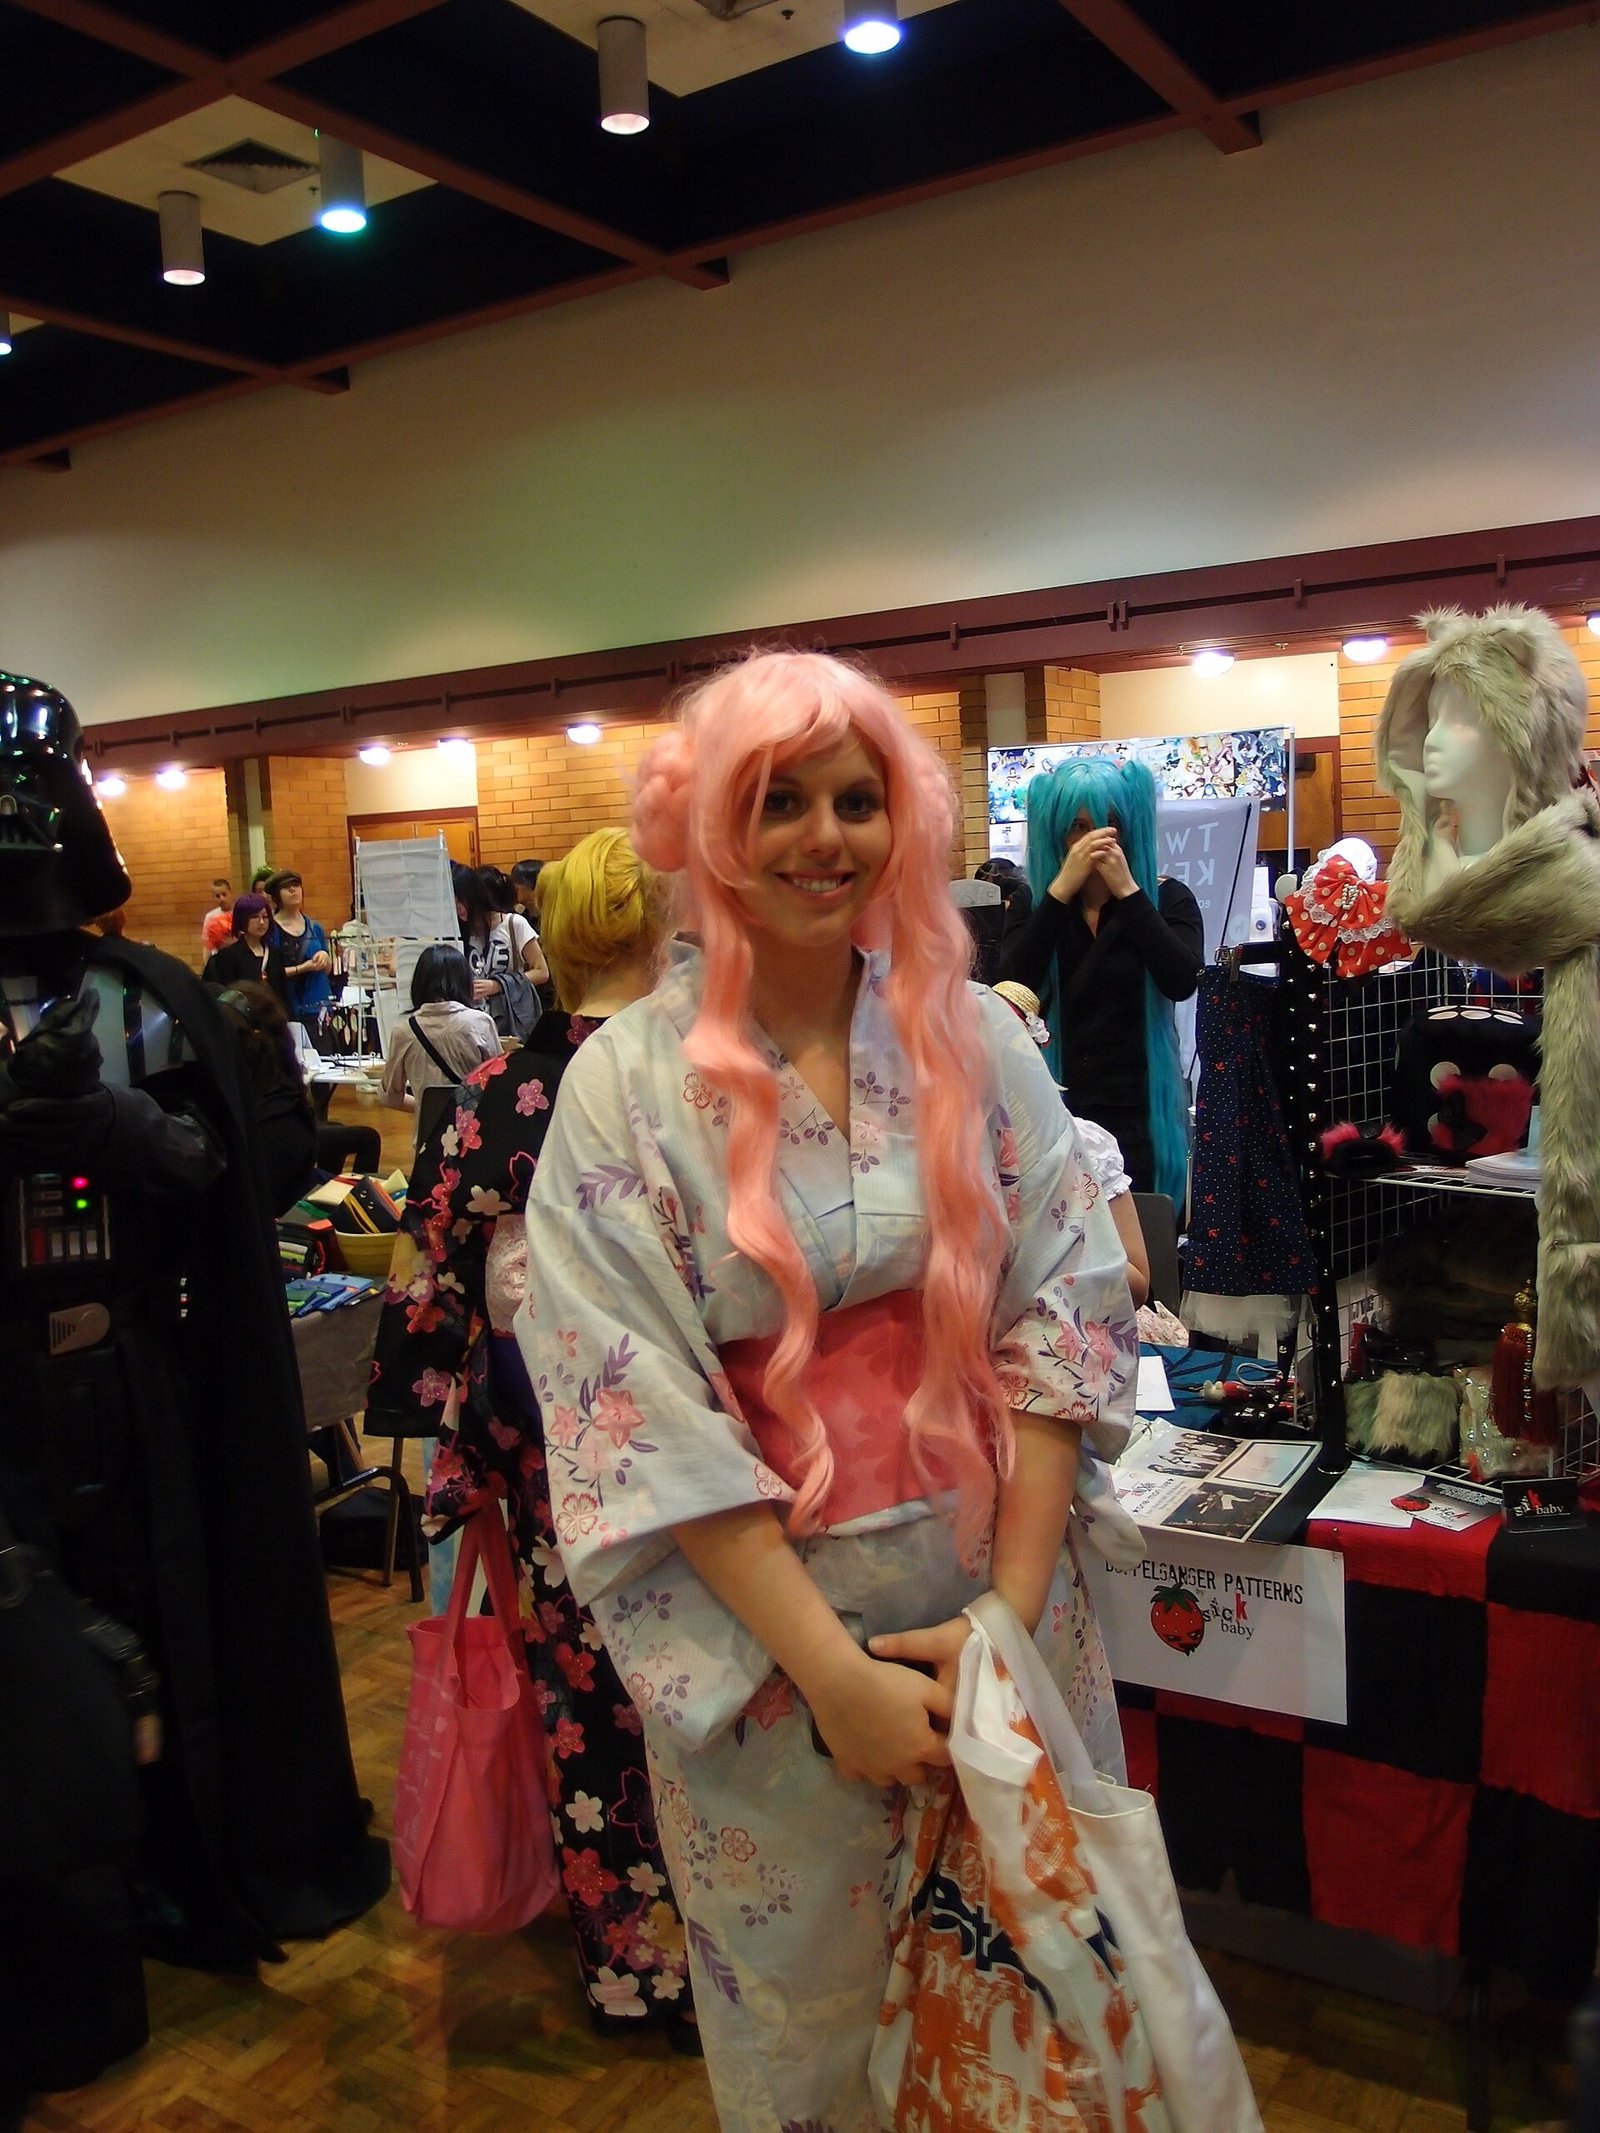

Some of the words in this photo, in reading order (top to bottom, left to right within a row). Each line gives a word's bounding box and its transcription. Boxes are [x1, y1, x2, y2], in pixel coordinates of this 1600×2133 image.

[1224, 1572, 1304, 1605] PATTERNS
[1202, 1592, 1248, 1622] sick
[1221, 1618, 1255, 1640] baby
